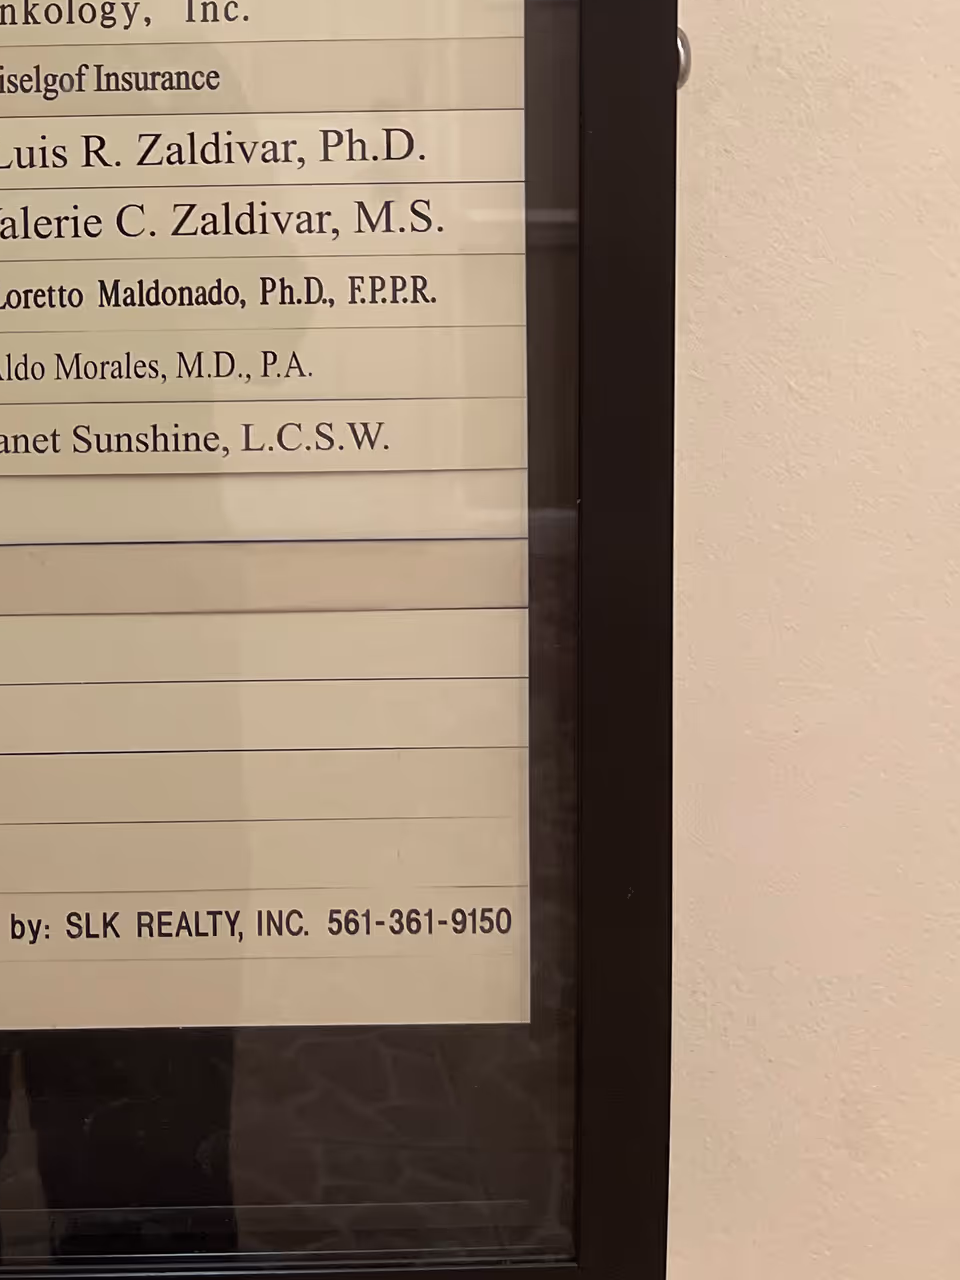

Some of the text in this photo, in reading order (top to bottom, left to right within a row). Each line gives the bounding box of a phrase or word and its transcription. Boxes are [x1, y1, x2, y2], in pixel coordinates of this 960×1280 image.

[92, 63, 220, 92] Insurance
[80, 134, 121, 168] R.
[136, 130, 306, 170] Zaldivar,
[318, 127, 426, 162] Ph.D.
[116, 203, 156, 238] C.
[170, 200, 340, 241] Zaldivar,
[353, 199, 444, 234] M.S.
[97, 277, 247, 309] Maldonado,
[259, 276, 335, 309] Ph.D.,
[347, 275, 437, 305] F.P.P.R.
[54, 351, 167, 383] Morales,
[175, 350, 251, 383] M.D.,
[260, 350, 313, 378] P.A.
[72, 423, 230, 458] Sunshine,
[240, 421, 390, 452] L.C.S.W.
[10, 913, 50, 945] by:
[65, 911, 121, 940] SLK
[136, 910, 244, 943] REALTY,
[257, 908, 309, 937] INC.
[327, 907, 512, 936] 561-361-9150
